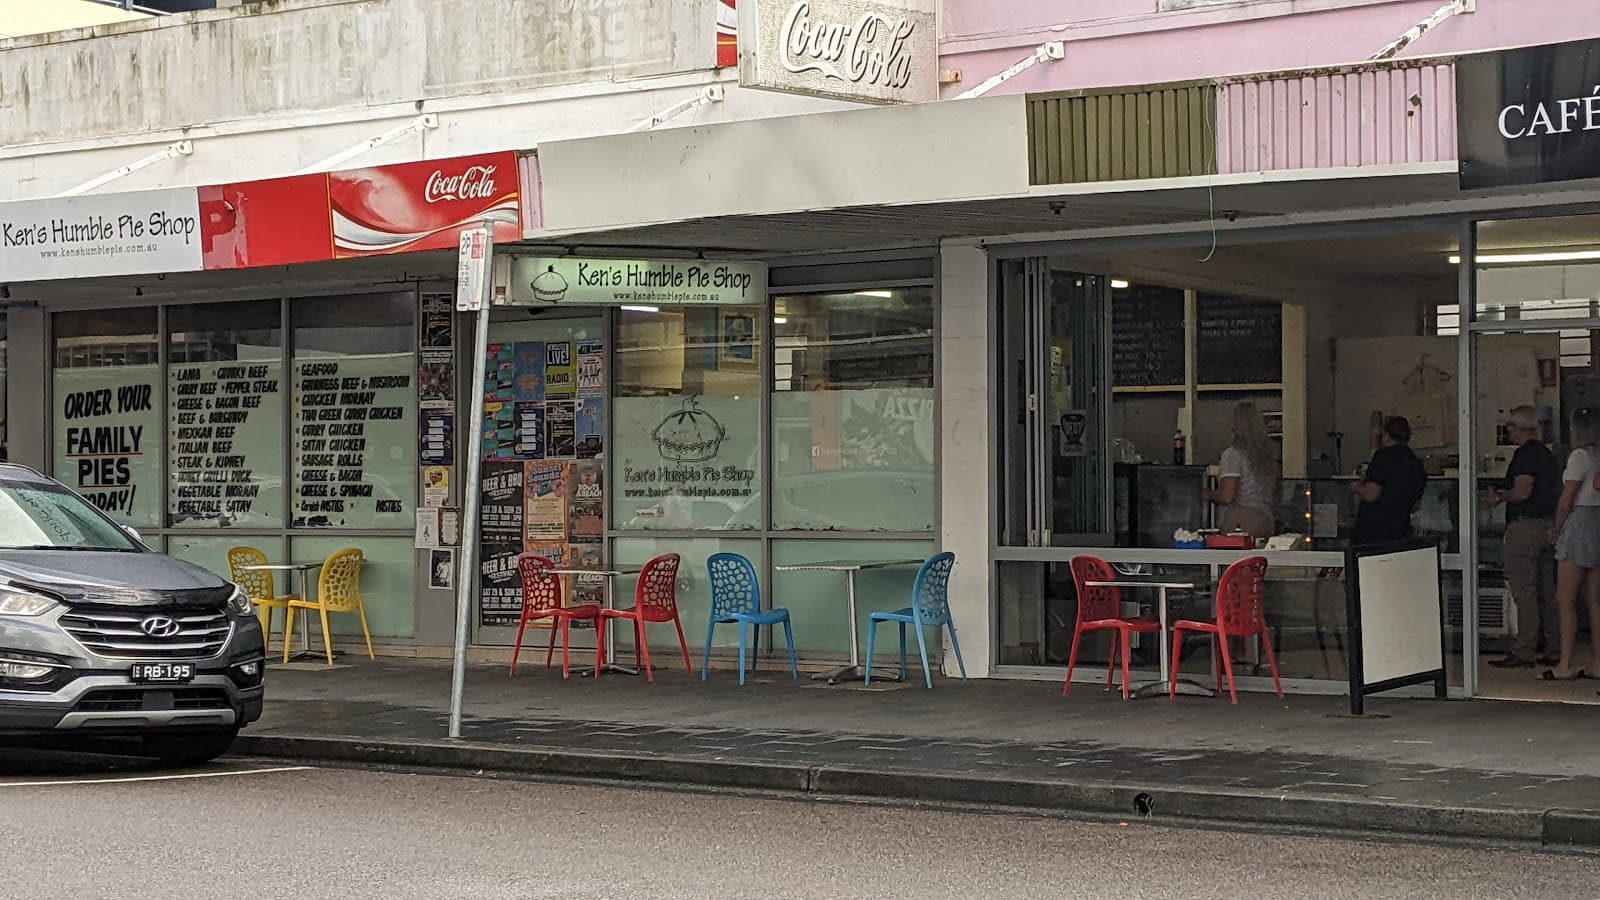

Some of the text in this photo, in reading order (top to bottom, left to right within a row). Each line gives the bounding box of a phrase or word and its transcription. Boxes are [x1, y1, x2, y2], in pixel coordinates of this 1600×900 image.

[780, 1, 916, 89] Coca-Cola
[1498, 84, 1600, 139] CAFÉ
[424, 164, 497, 203] Coca-Cola
[3, 210, 195, 247] Ken's Humble Pie Shop
[578, 262, 750, 297] Ken's Humble Pie Shop
[177, 368, 200, 381] LAMB
[248, 366, 268, 378] BEEF
[301, 363, 338, 376] SEAFOOD
[341, 377, 360, 390] BEEF
[362, 379, 367, 388] &
[546, 373, 569, 385] RADIO
[200, 382, 217, 394] BEEF
[225, 381, 250, 394] PEPPER
[253, 380, 278, 393] STEAK
[64, 384, 151, 420] ORDER YOUR
[178, 395, 262, 410] CHEESE & BACON BEEF
[302, 392, 375, 406] CHICKEN MORNAY
[178, 412, 196, 424] BEEF
[200, 413, 205, 424] &
[319, 408, 341, 421] GREEN
[369, 407, 403, 420] CHICKEN
[178, 426, 235, 440] MEXICAN BEEF
[302, 423, 363, 437] CURRY CHICKEN
[66, 425, 143, 454] FAMILY
[302, 438, 366, 451] SATAY CHICKEN
[178, 440, 233, 454] ITALIAN BEEF
[178, 456, 245, 469] STEAK & KIDNEY
[301, 454, 363, 467] SAUSAGE ROLLS
[78, 457, 130, 485] PIES
[301, 470, 328, 482] CHEESE
[338, 470, 362, 482] BACON
[532, 463, 562, 475] Sunset
[500, 474, 506, 487] &
[528, 471, 560, 483] Sounds
[624, 465, 755, 488] Ken's Humble Pie Shop
[178, 486, 220, 498] VEGETABLE
[301, 484, 373, 498] CHEESE & SPINACH
[178, 500, 252, 513] VEGETABLE SATAY
[376, 500, 402, 513] PASTIES
[500, 557, 506, 570] &
[508, 555, 519, 569] BB
